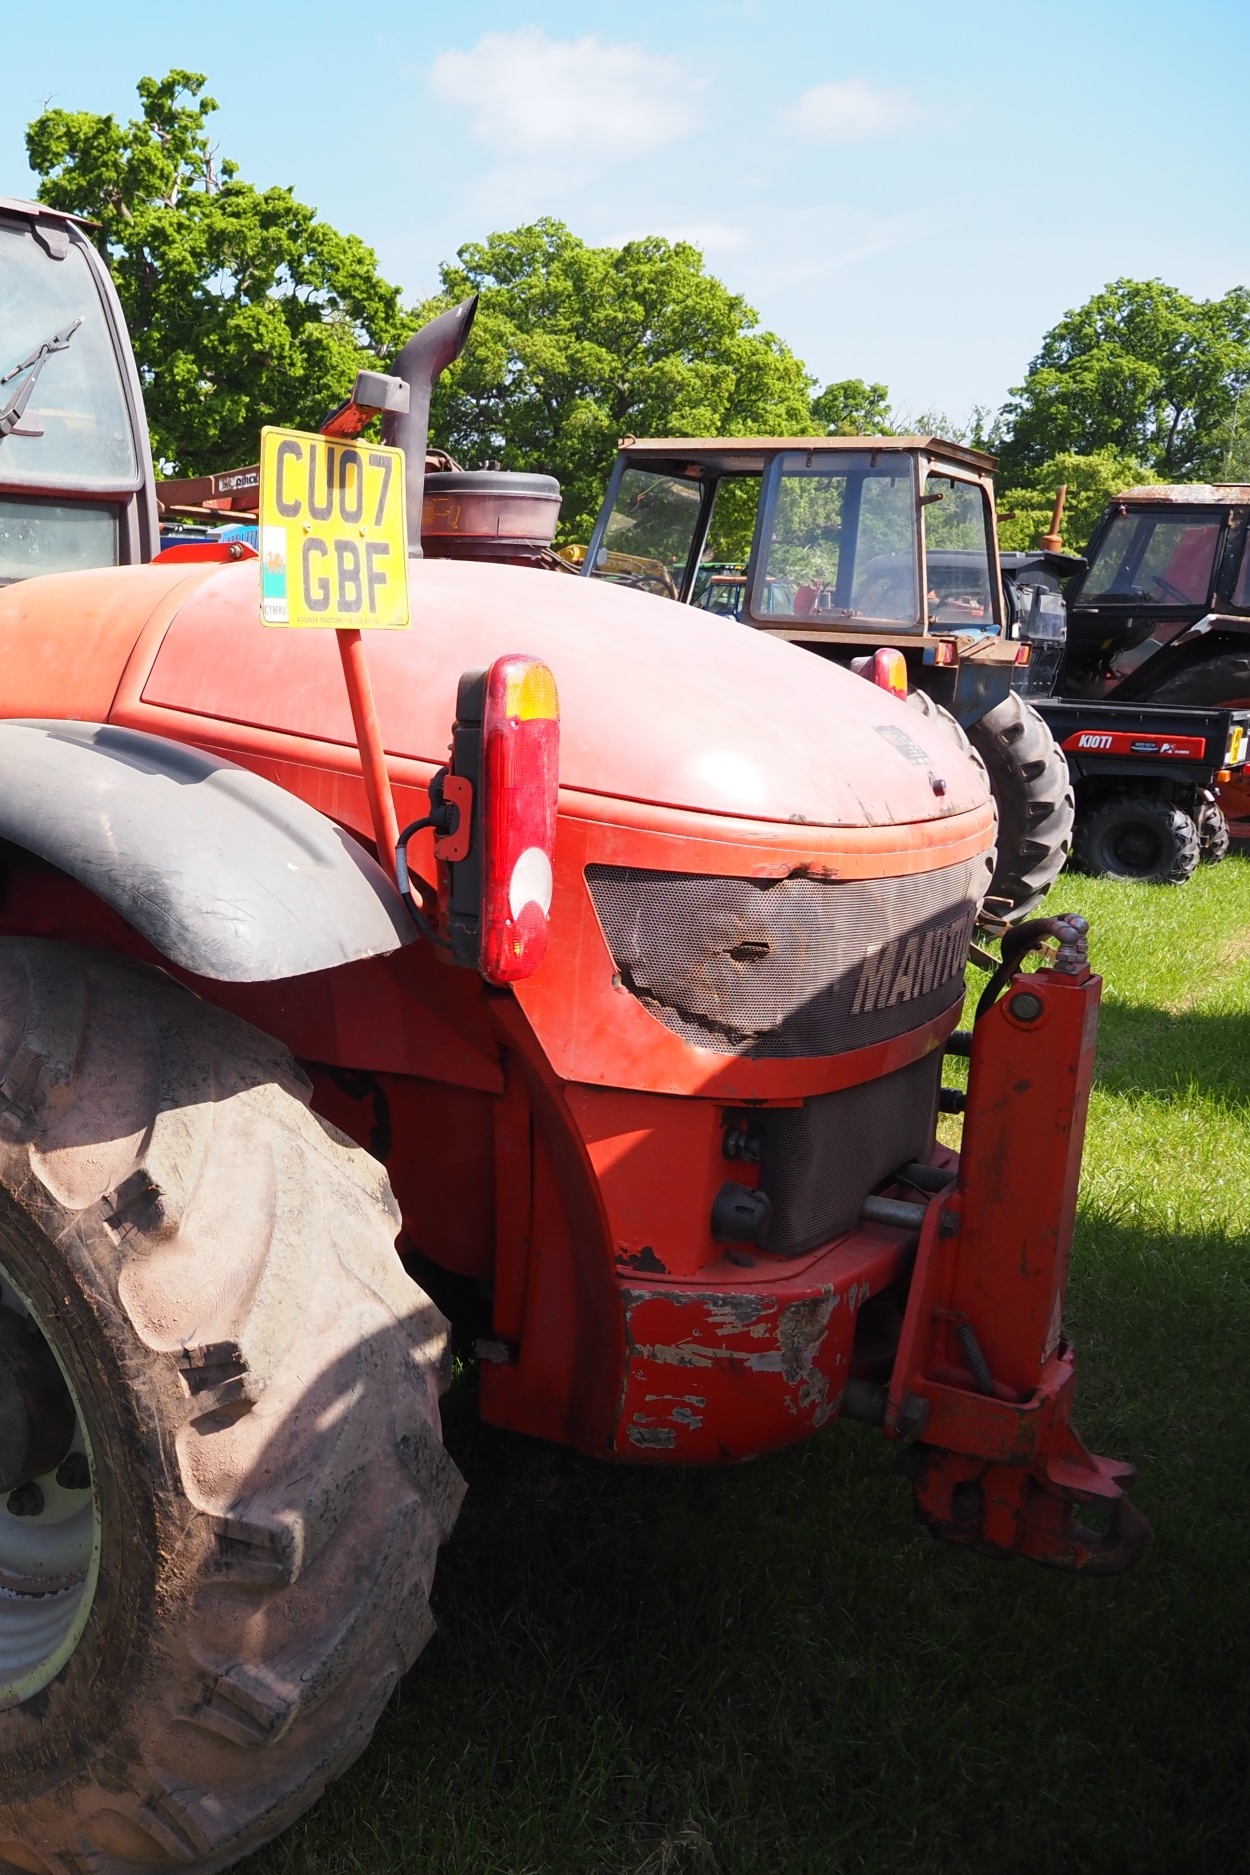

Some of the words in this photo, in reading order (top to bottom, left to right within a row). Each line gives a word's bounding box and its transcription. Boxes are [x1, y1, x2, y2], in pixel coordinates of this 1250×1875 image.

[275, 439, 393, 527] CU07
[264, 604, 287, 616] CYMRU
[301, 537, 391, 614] GBF
[1078, 734, 1114, 749] KIOTI
[850, 909, 971, 1015] MANITOU
